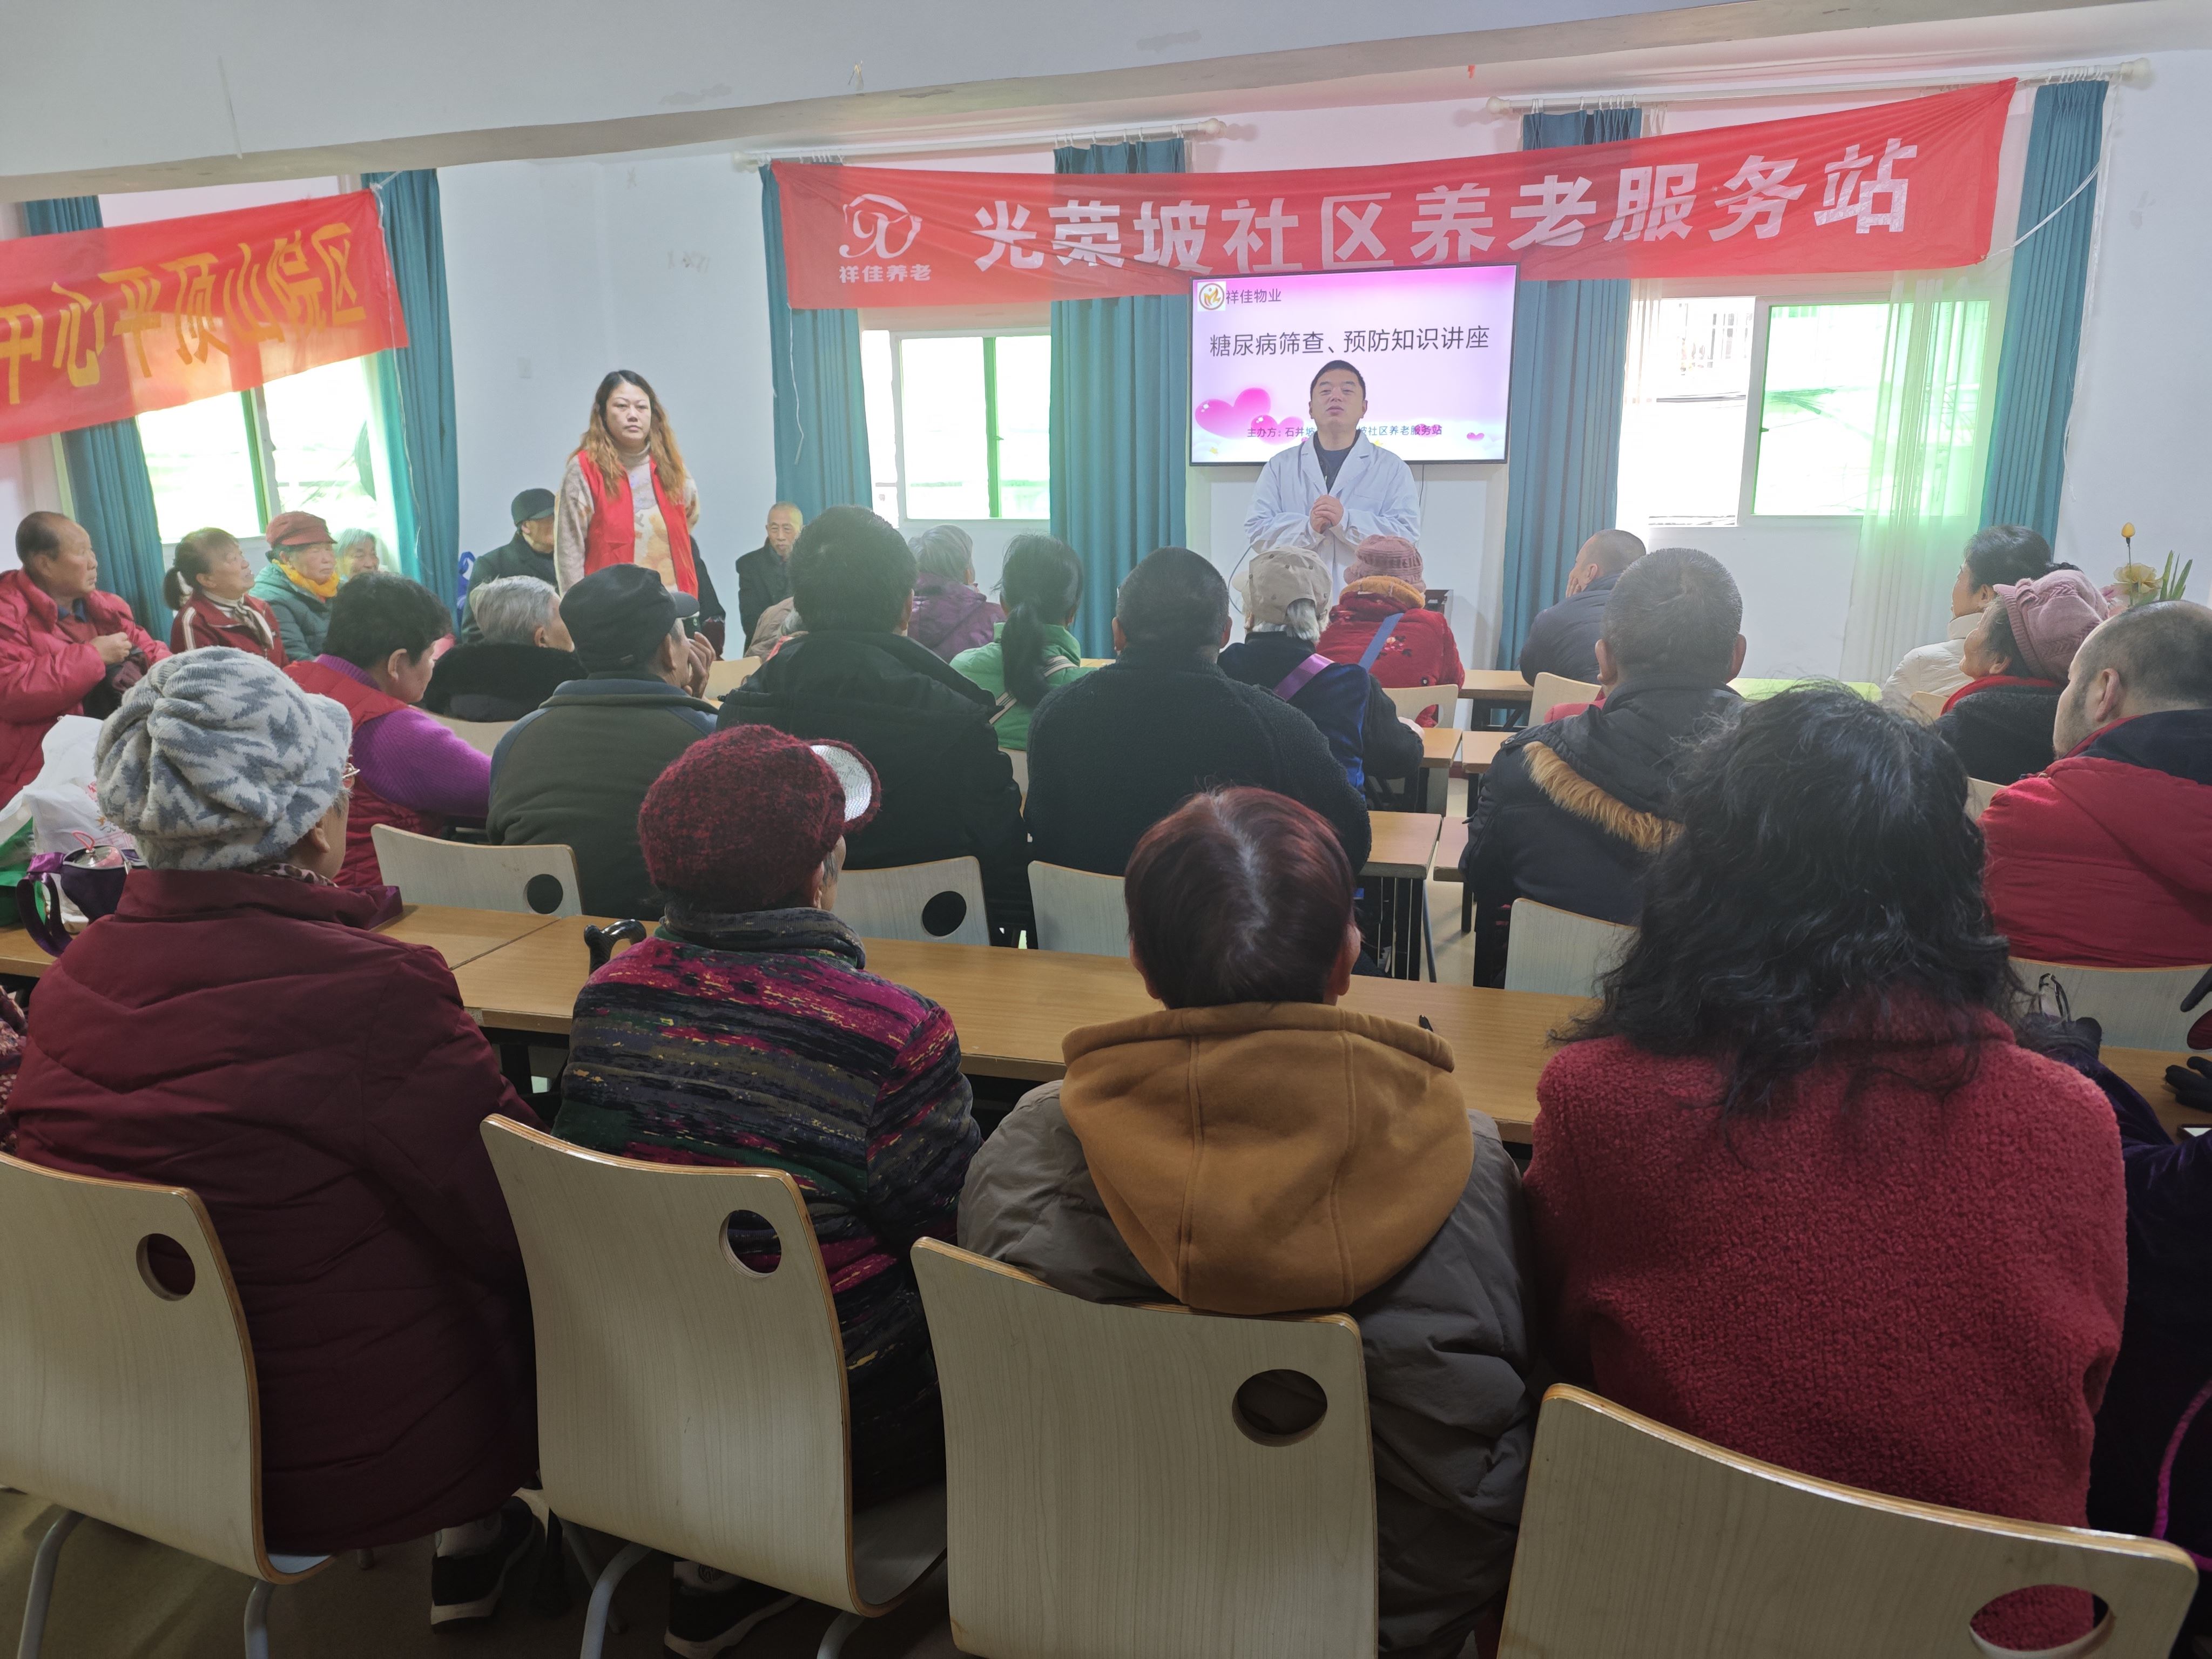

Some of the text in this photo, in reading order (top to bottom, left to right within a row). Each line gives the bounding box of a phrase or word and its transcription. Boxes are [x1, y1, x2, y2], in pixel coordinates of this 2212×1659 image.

[972, 138, 1918, 275] 光荣坡社区养老服务站
[839, 264, 931, 283] 祥佳养老
[1225, 288, 1282, 305] 祥佳物业
[0, 222, 366, 405] 中心平顶山院区
[1210, 325, 1490, 357] 糖尿病筛查、预防知识讲座
